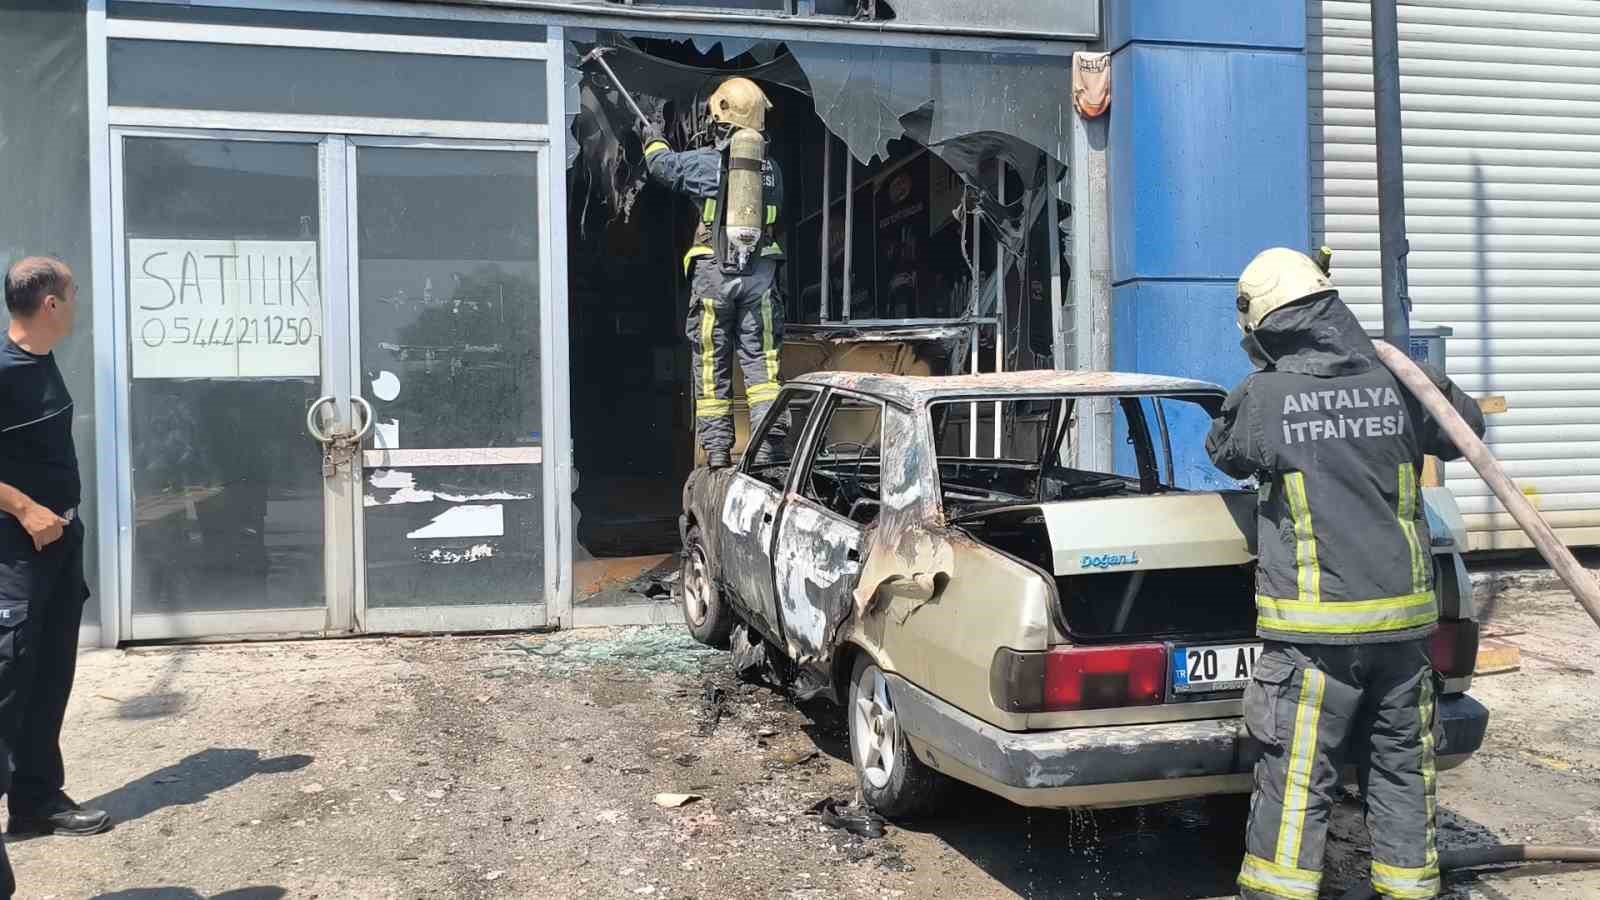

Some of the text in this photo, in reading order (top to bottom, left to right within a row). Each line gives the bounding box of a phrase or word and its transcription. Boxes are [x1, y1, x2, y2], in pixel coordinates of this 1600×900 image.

[140, 251, 312, 310] SATILIK
[1283, 387, 1400, 415] ANTALYA
[1283, 410, 1404, 444] İTFAİYESİ
[1175, 670, 1186, 678] TR
[1188, 649, 1218, 682] 20
